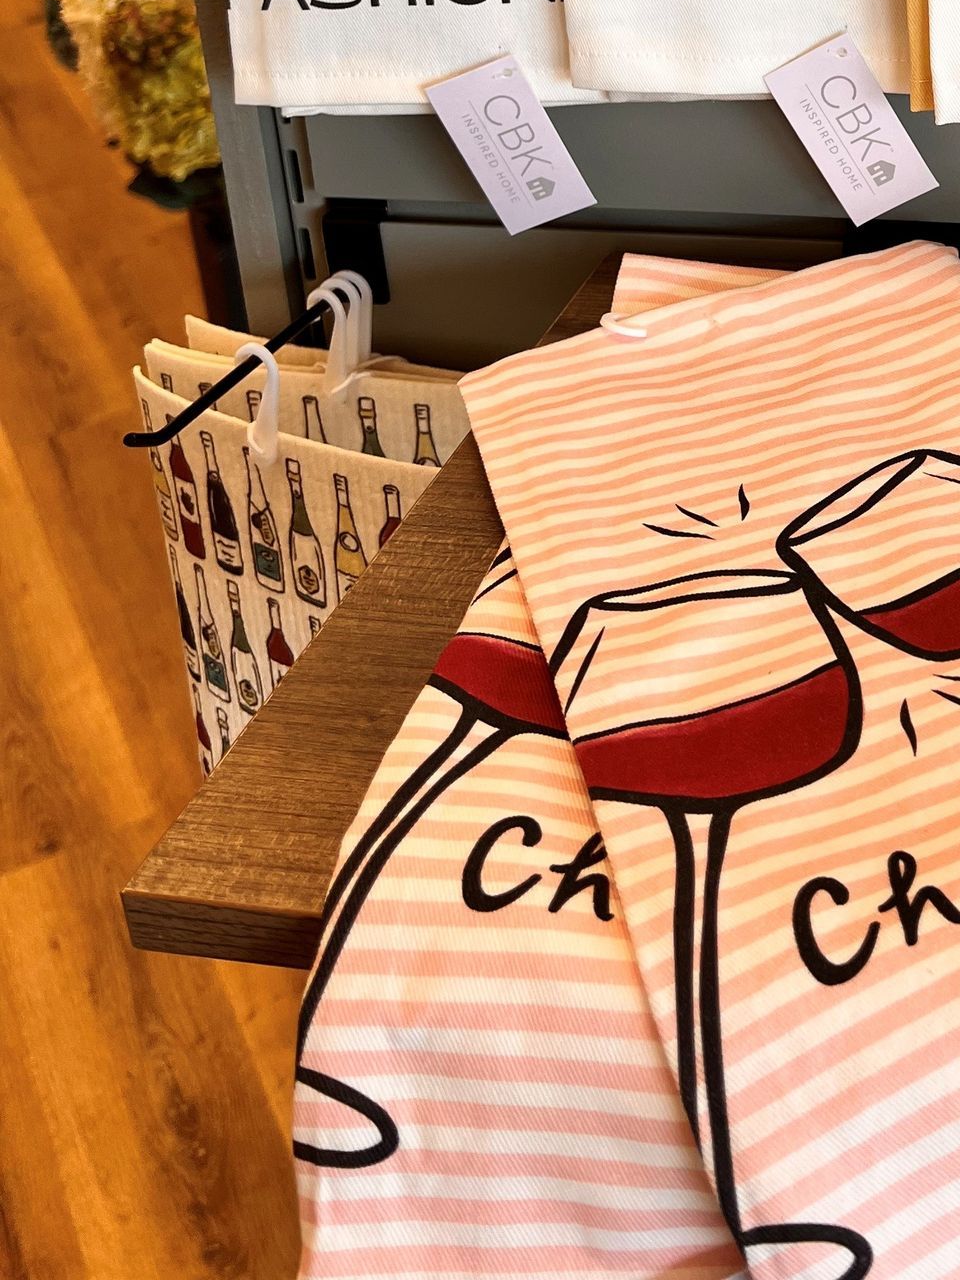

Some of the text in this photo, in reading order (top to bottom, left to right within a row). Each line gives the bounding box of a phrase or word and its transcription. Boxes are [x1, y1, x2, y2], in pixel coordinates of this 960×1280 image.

[461, 113, 521, 204] INSPIRED HOME
[483, 95, 552, 177] CBK
[799, 98, 863, 191] INSPIRED HOME
[821, 75, 892, 162] CBK
